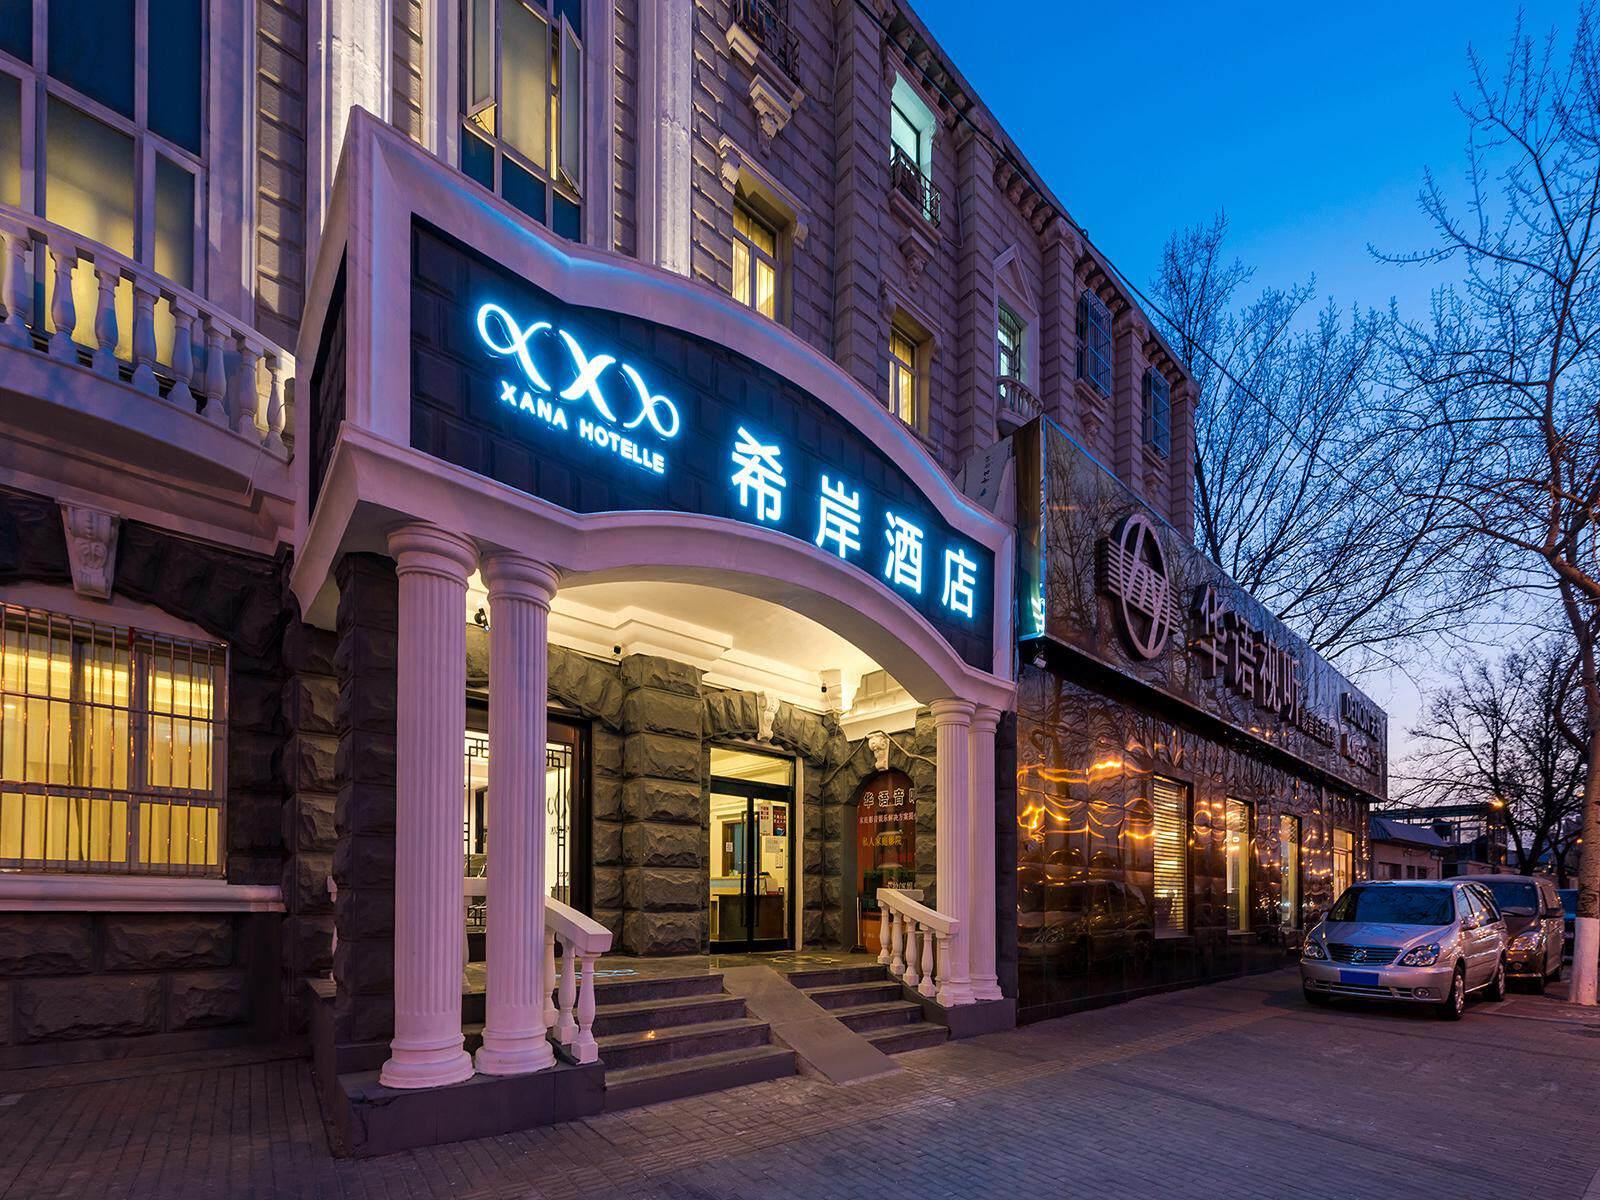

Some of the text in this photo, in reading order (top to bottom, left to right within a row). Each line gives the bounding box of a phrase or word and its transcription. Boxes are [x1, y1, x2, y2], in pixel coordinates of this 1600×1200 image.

[500, 380, 666, 474] XANA HOTELLE
[730, 425, 979, 619] 希岸酒店
[1200, 582, 1303, 726] 华语视听
